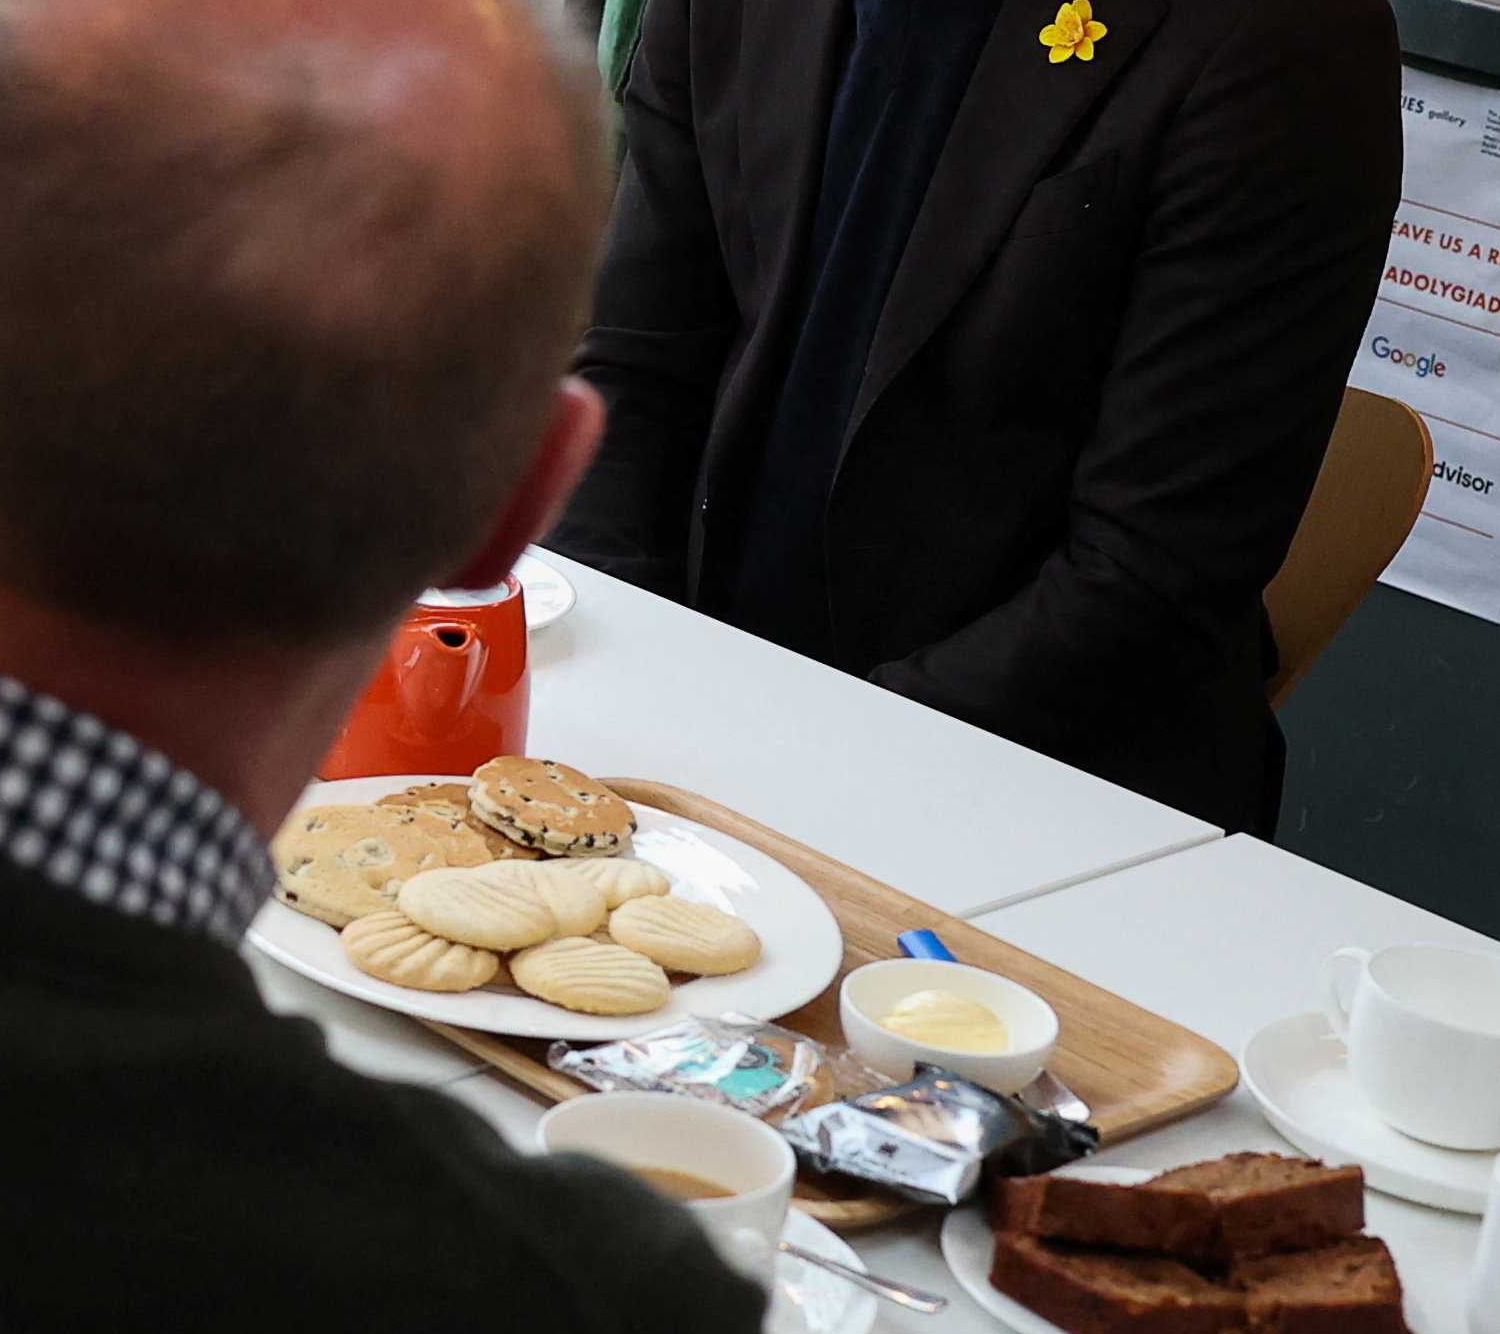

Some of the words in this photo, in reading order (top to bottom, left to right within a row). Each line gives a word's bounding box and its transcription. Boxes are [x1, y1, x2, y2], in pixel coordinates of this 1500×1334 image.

[1400, 95, 1425, 114] IES
[1428, 108, 1467, 127] gallery
[1439, 233, 1464, 254] US
[1468, 243, 1481, 260] A
[1372, 336, 1447, 378] Google
[1433, 461, 1495, 495] dvisor
